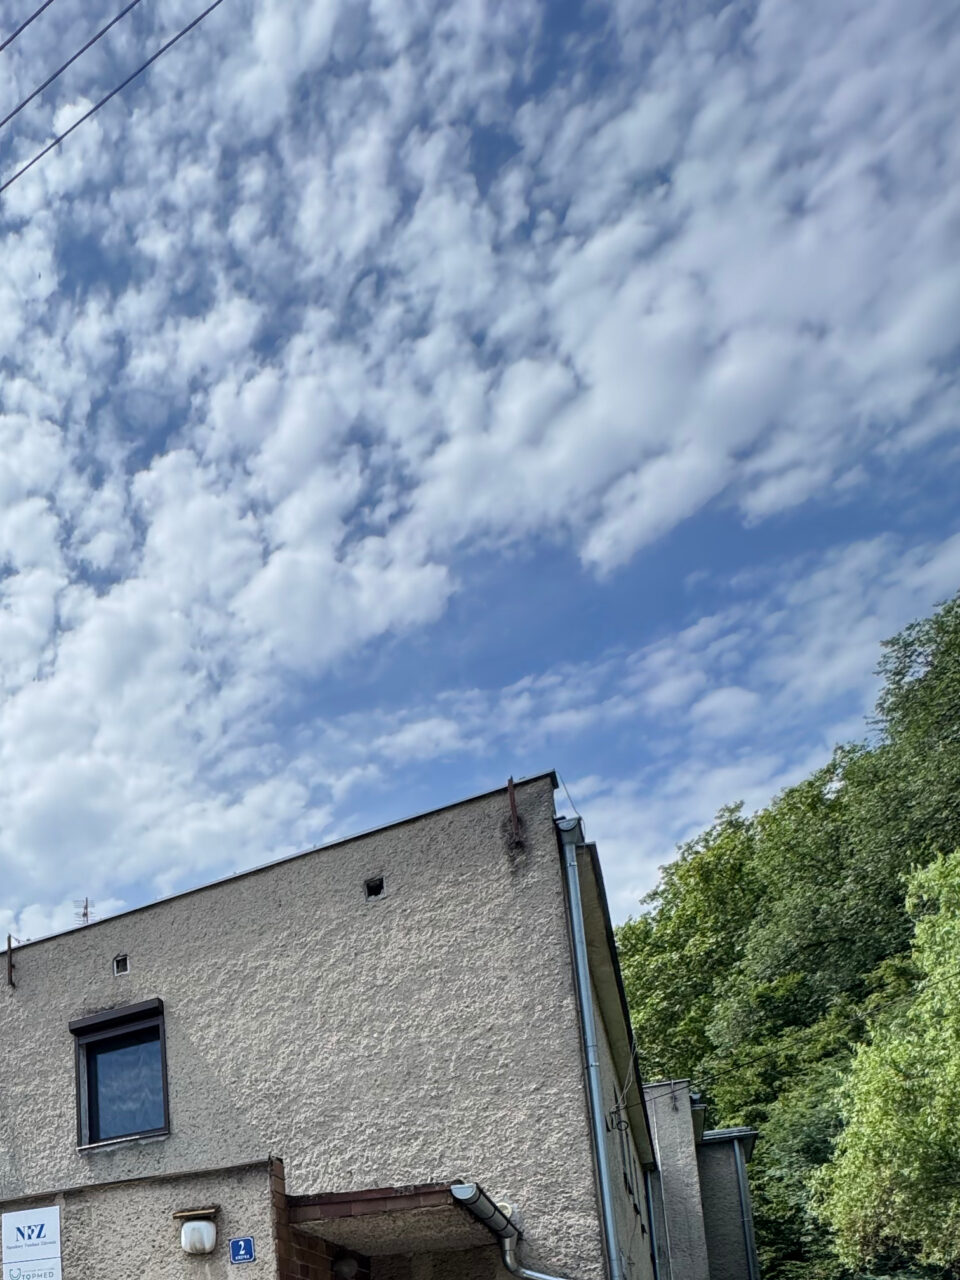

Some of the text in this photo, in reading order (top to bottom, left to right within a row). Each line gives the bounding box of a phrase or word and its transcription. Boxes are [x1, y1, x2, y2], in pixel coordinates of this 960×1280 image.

[16, 1223, 47, 1242] NFZ
[238, 1241, 246, 1255] 2
[21, 1271, 55, 1280] TOPMED
